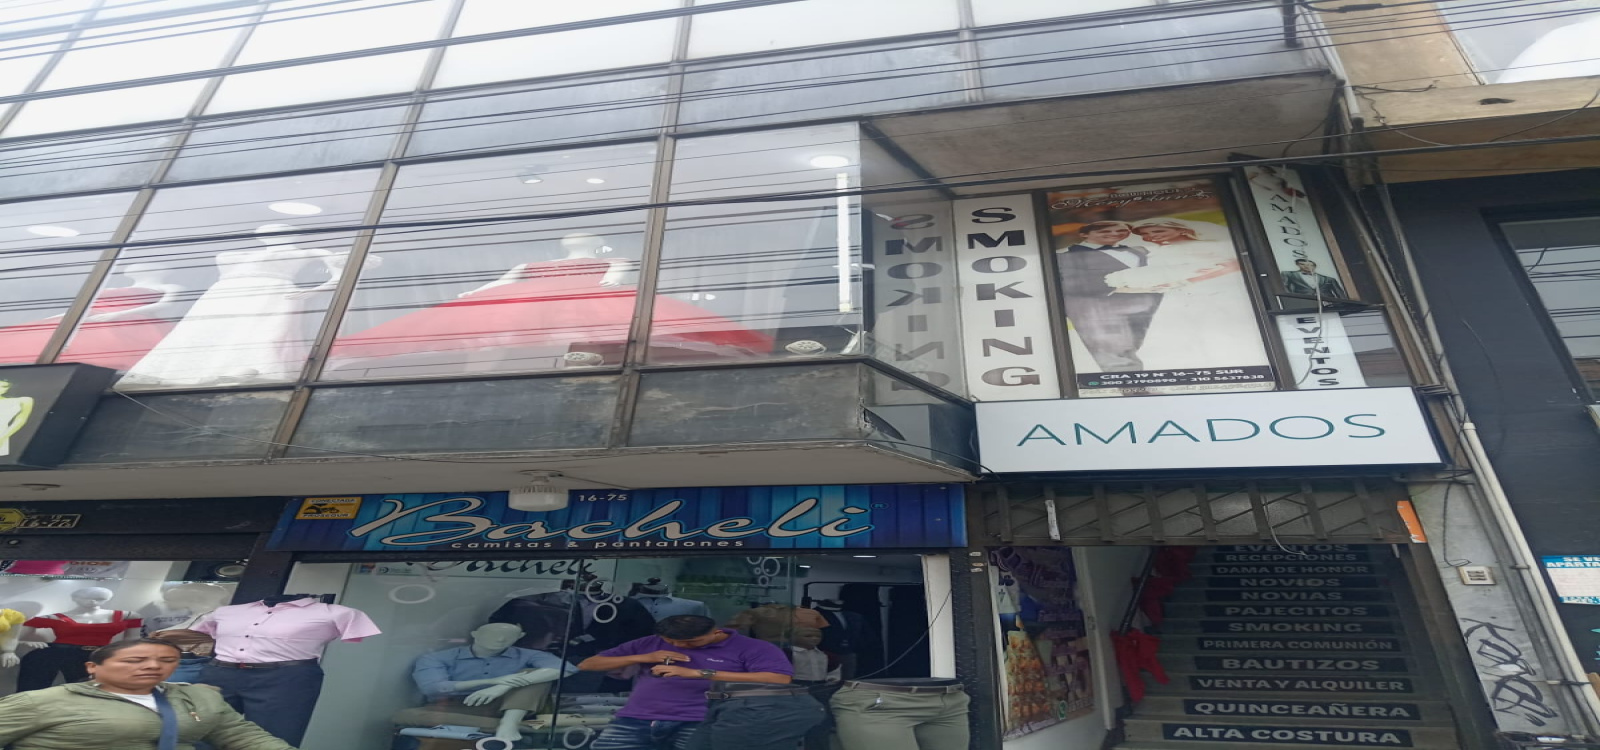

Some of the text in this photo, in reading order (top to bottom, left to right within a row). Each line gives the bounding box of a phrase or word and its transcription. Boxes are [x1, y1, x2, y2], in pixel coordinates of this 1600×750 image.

[967, 207, 1041, 387] SMOKING
[1296, 316, 1340, 387] EVENTOS
[1017, 413, 1386, 447] AMADOS
[578, 494, 627, 502] 16-75
[351, 496, 873, 547] Bacheli
[451, 538, 745, 551] camisas & pantalones
[1225, 553, 1358, 562] RECEPCIONES
[1216, 565, 1369, 575] DAMA DE HONOR
[1240, 578, 1342, 587] NOVIOS
[1241, 591, 1343, 600] NOVIAS
[1226, 606, 1368, 616] PAJECITOS
[1228, 622, 1363, 633] SMOKING
[1204, 639, 1392, 650] PRIMERA COMUNIÓN
[1222, 658, 1380, 671] BAUTIZOS
[1197, 678, 1405, 691] VENTA Y ALQUILER
[1194, 702, 1411, 718] QUINCEAÑERA
[1173, 727, 1401, 744] ALTA COSTURA
